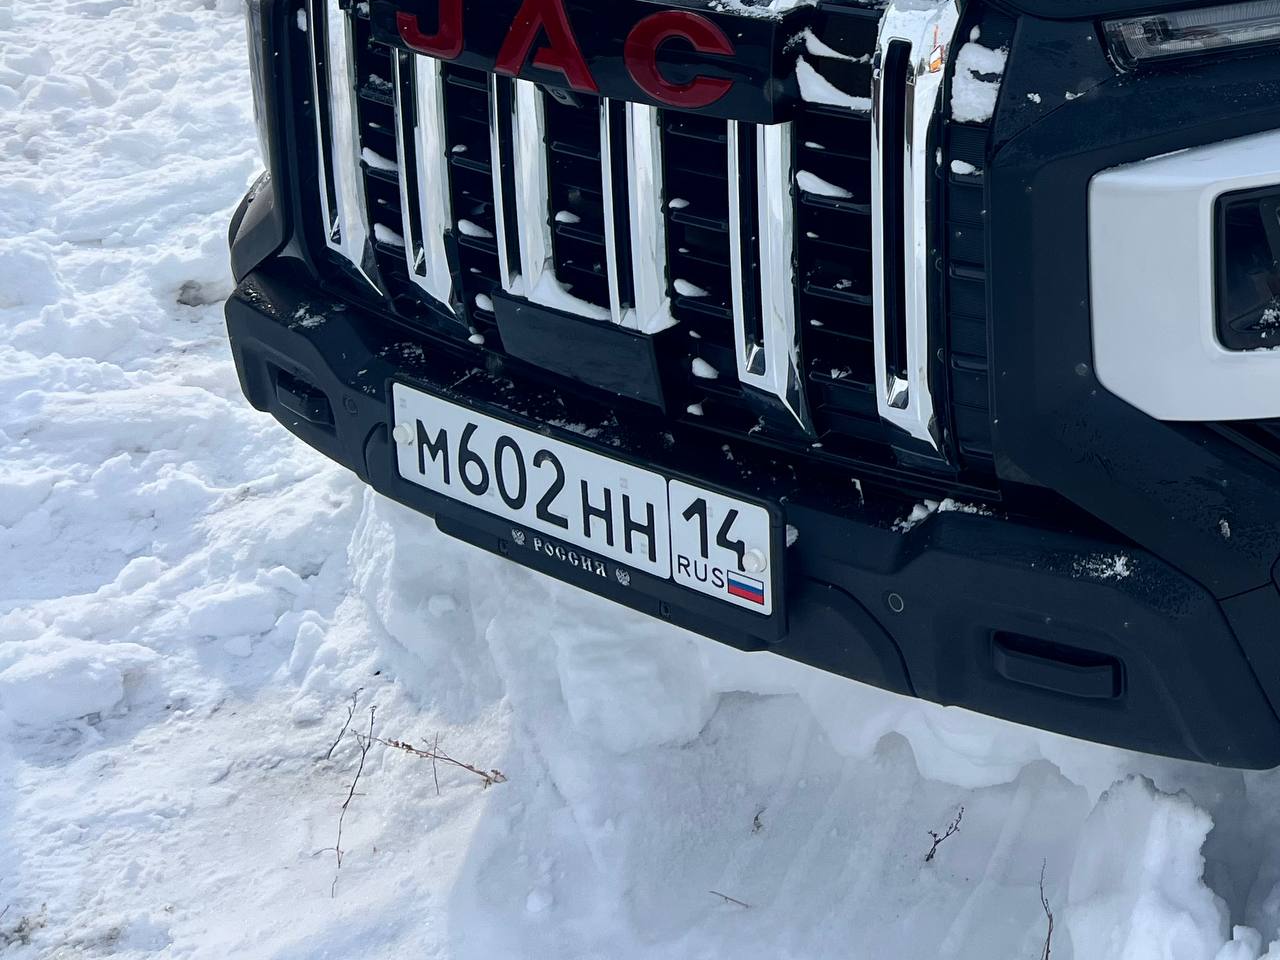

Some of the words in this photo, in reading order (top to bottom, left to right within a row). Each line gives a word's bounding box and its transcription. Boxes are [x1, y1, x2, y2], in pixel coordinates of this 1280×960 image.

[415, 418, 657, 563] М602НН
[682, 497, 746, 572] 14
[533, 536, 609, 579] РОССИЯ
[677, 554, 725, 588] RUS
